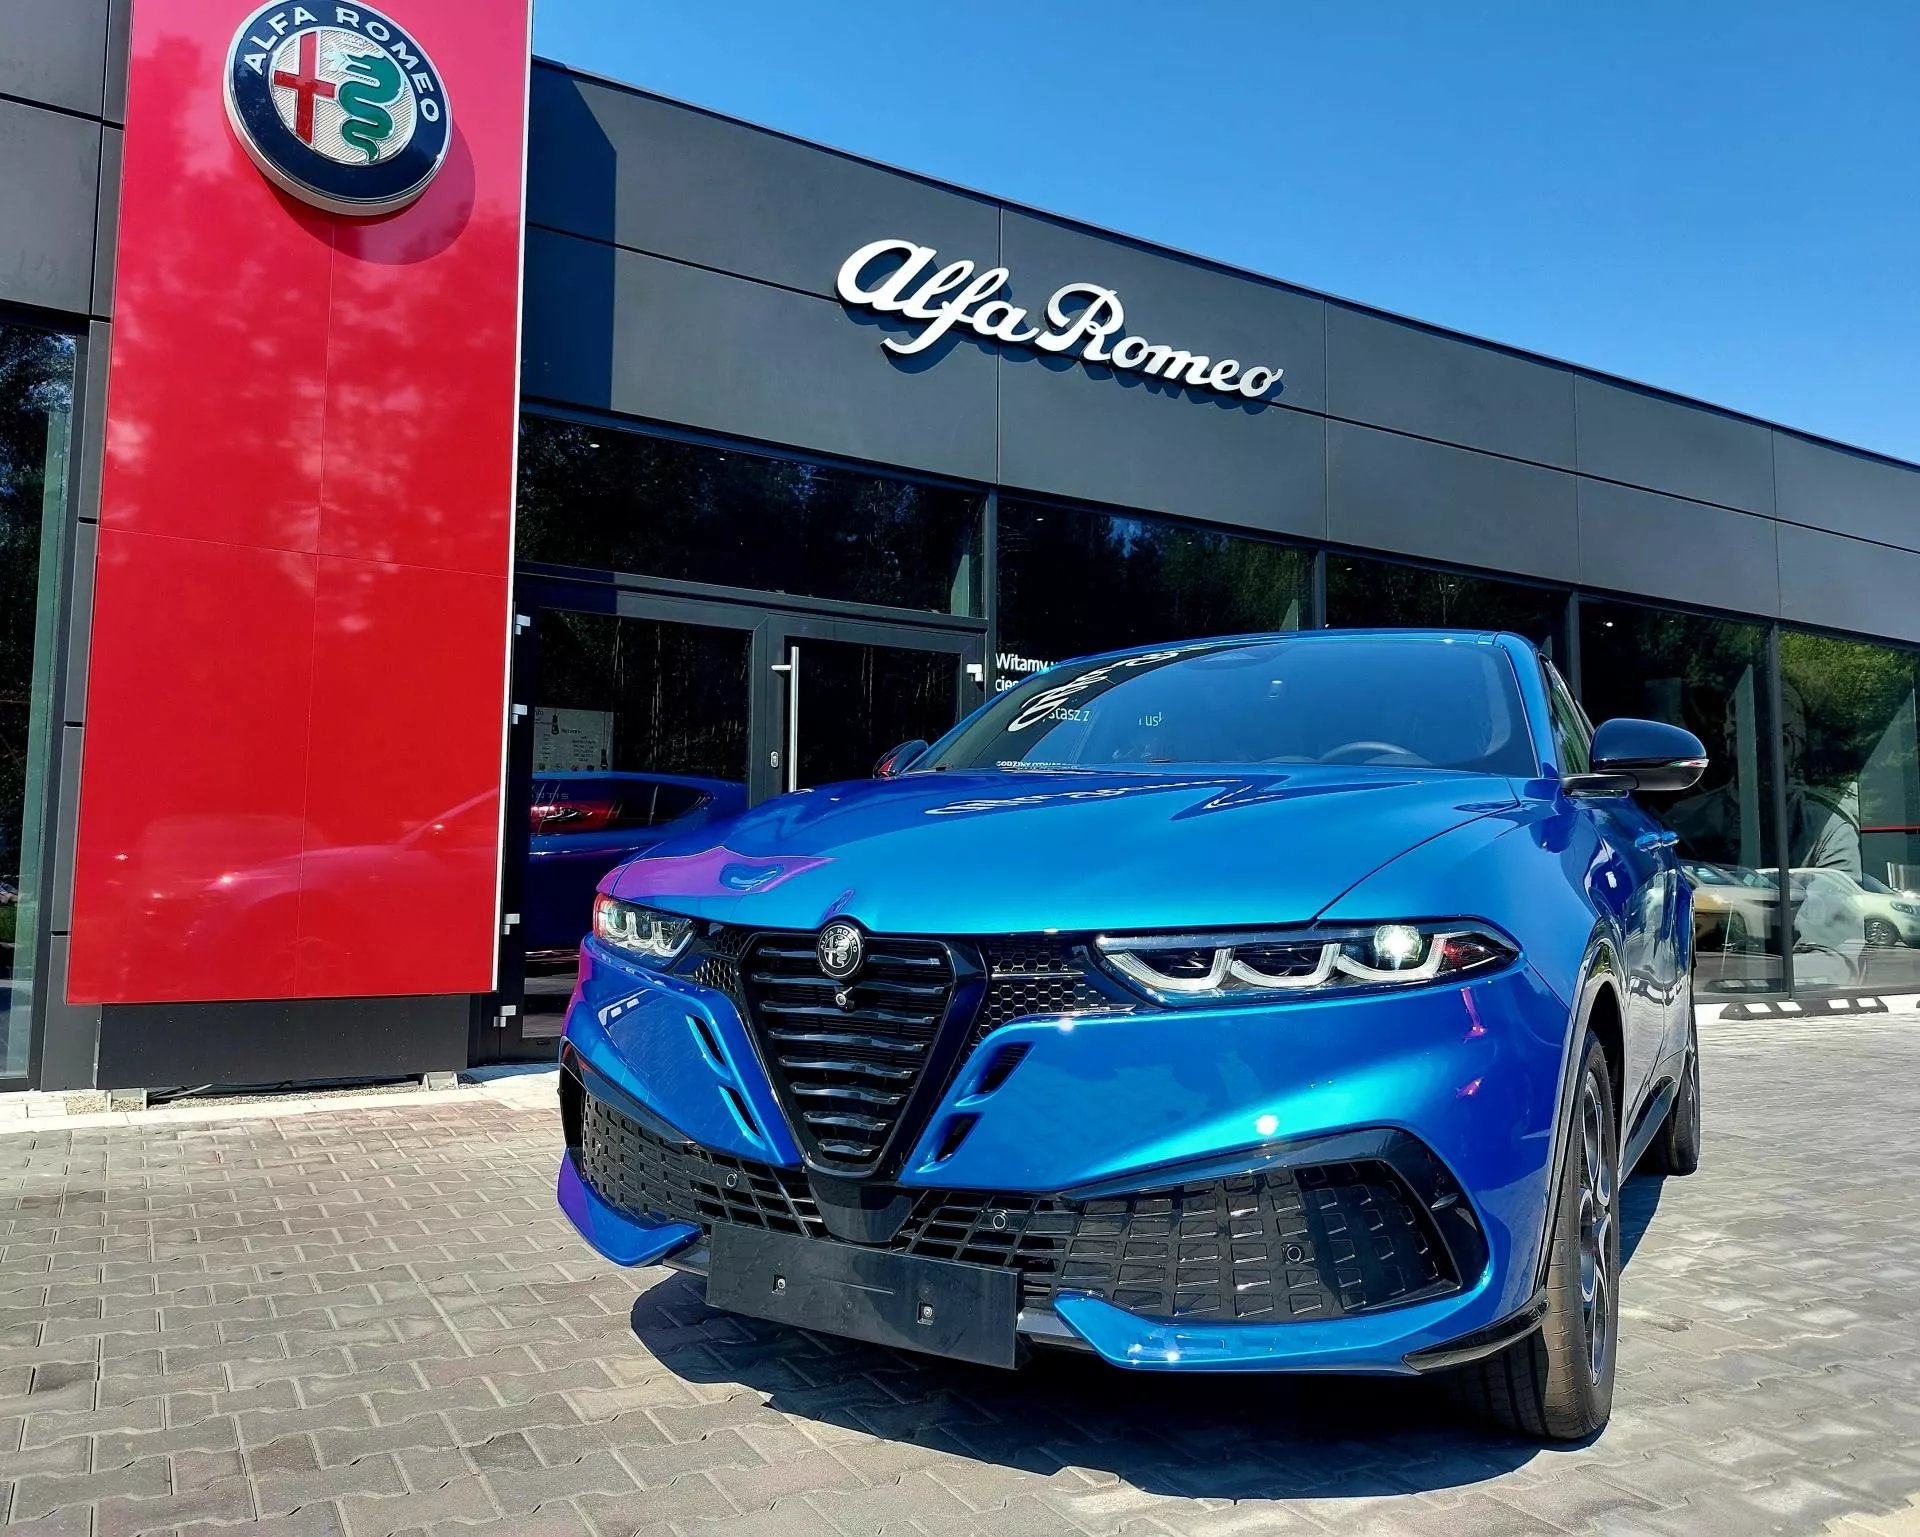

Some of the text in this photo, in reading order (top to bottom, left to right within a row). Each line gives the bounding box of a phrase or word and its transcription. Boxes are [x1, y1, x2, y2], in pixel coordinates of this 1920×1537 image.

[243, 6, 440, 122] ALFA ROMEO
[836, 239, 1284, 398] Alfa Romeo
[995, 652, 1049, 673] Witamy
